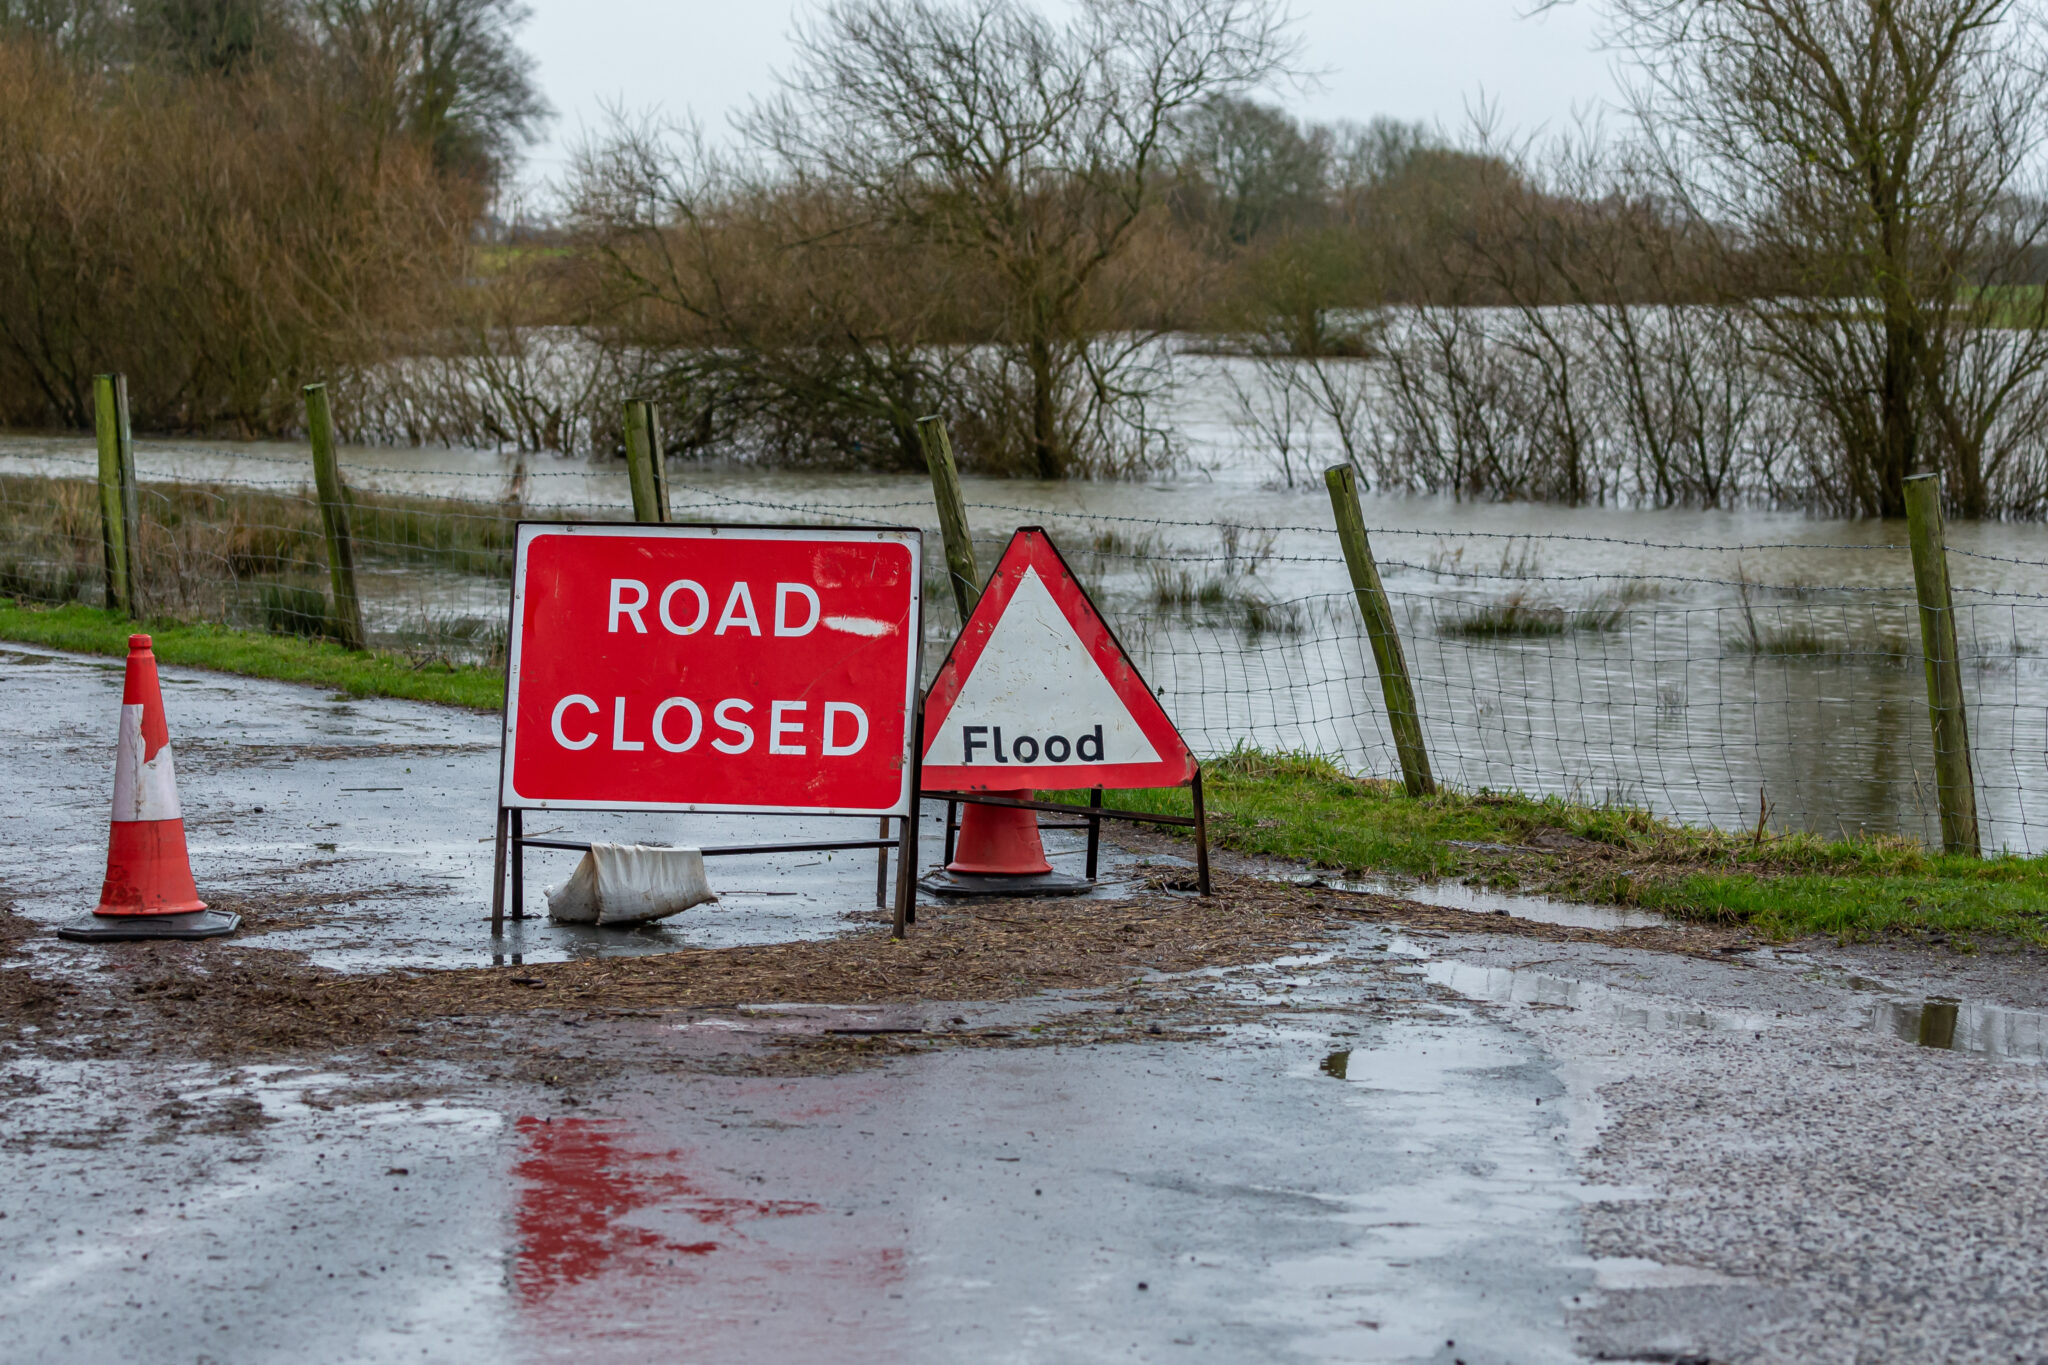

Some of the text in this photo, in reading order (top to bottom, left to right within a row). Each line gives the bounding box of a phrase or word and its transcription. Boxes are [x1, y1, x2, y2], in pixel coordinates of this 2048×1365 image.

[608, 578, 821, 637] ROAD
[550, 693, 869, 757] CLOSED
[962, 724, 1105, 764] Flood
